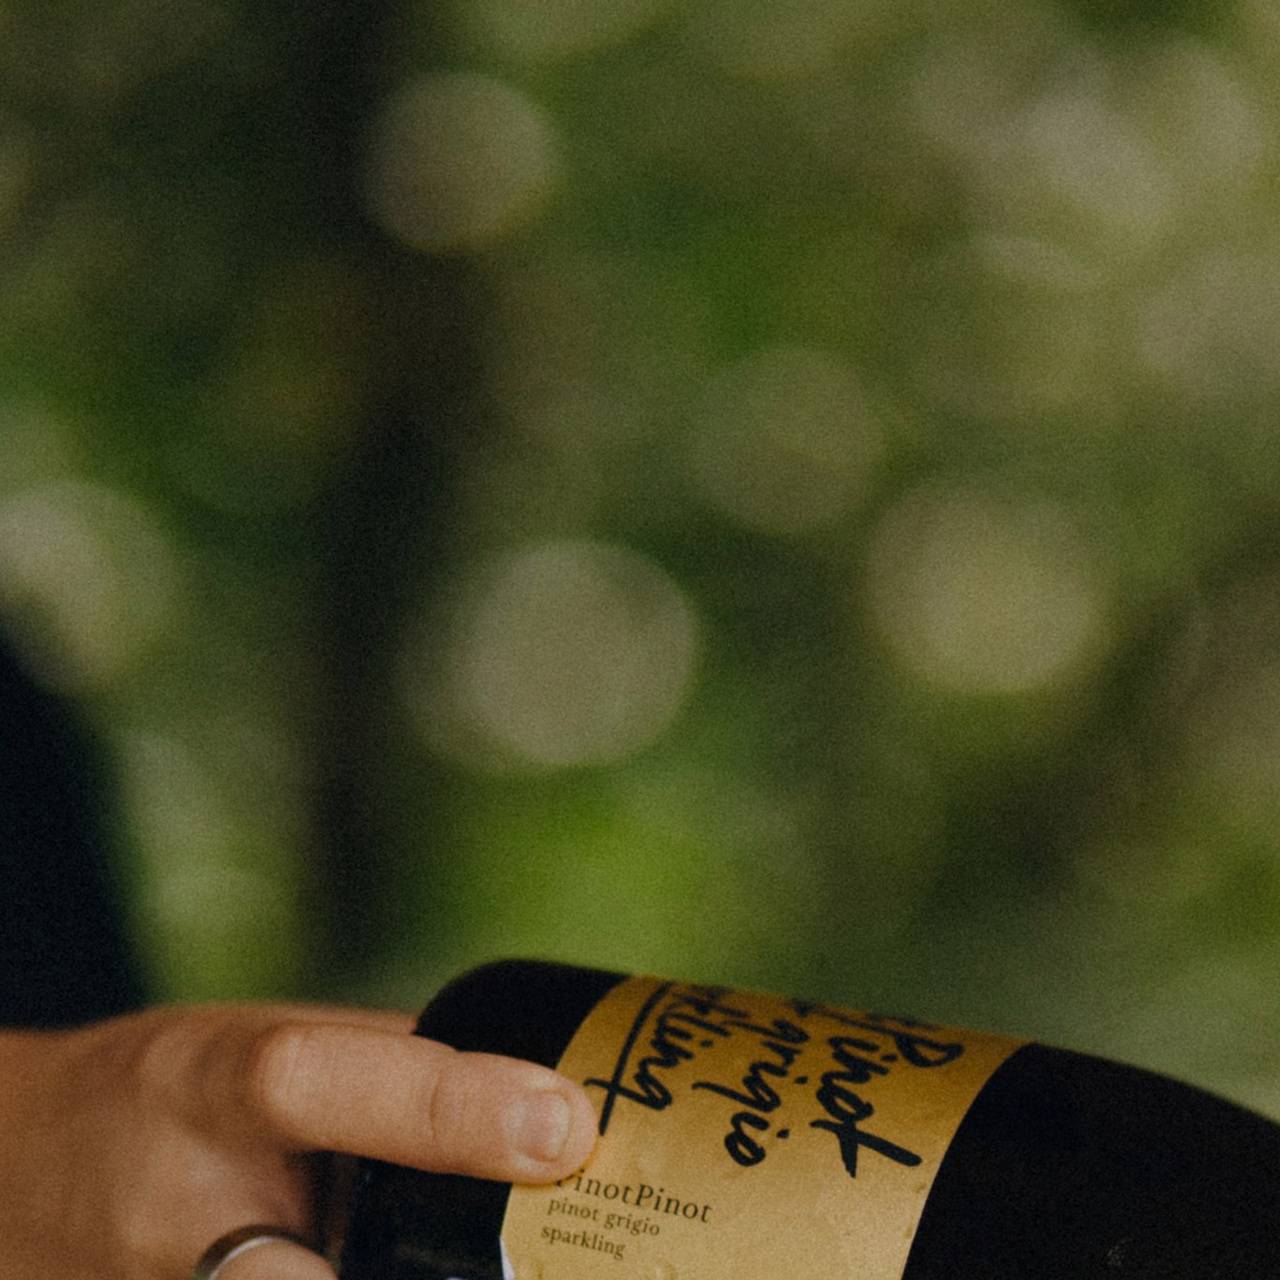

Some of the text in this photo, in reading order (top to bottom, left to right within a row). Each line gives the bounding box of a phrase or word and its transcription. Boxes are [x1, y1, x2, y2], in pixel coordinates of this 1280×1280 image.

[808, 1008, 964, 1178] Pinot
[547, 1196, 661, 1236] pinot grigio
[540, 1224, 627, 1260] sparkling
